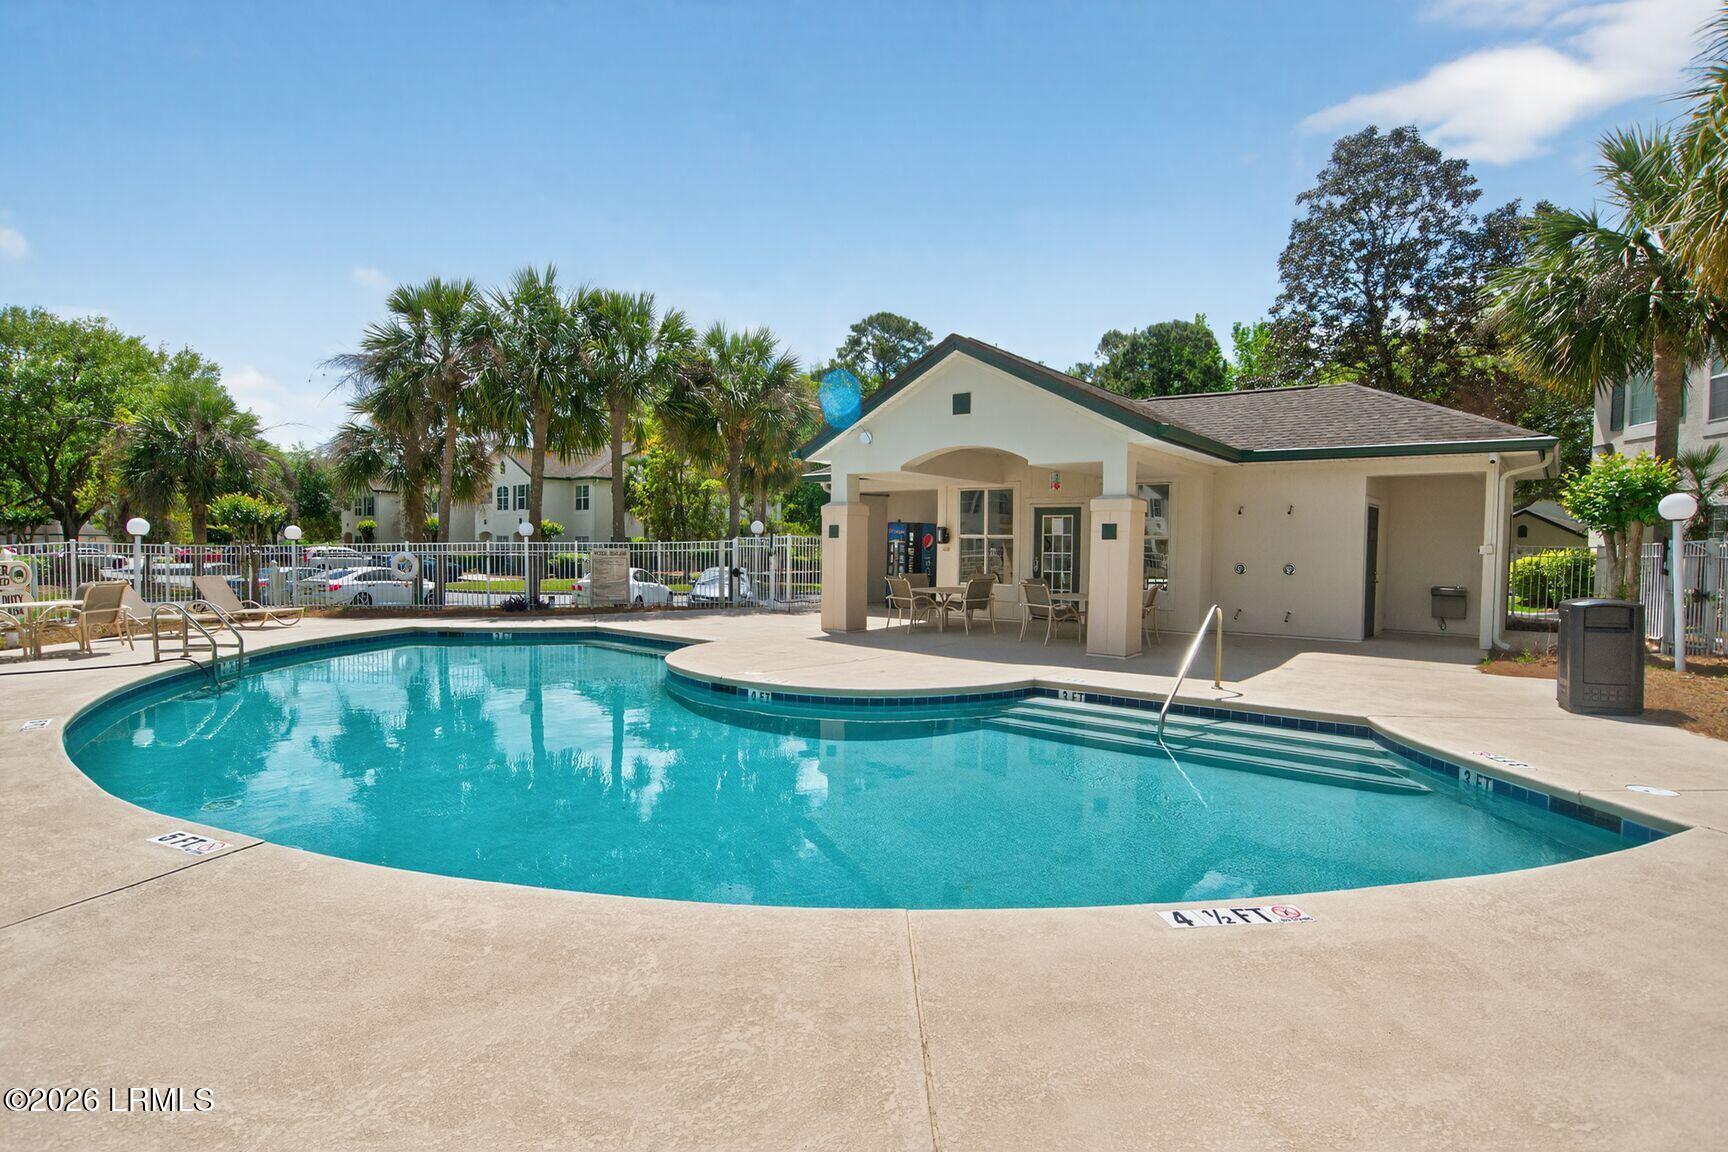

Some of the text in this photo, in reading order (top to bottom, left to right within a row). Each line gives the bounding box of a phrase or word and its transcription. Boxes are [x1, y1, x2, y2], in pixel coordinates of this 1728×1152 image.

[1476, 773, 1492, 792] FT
[169, 836, 208, 848] FT
[1171, 910, 1195, 927] 4
[1229, 907, 1273, 923] FT
